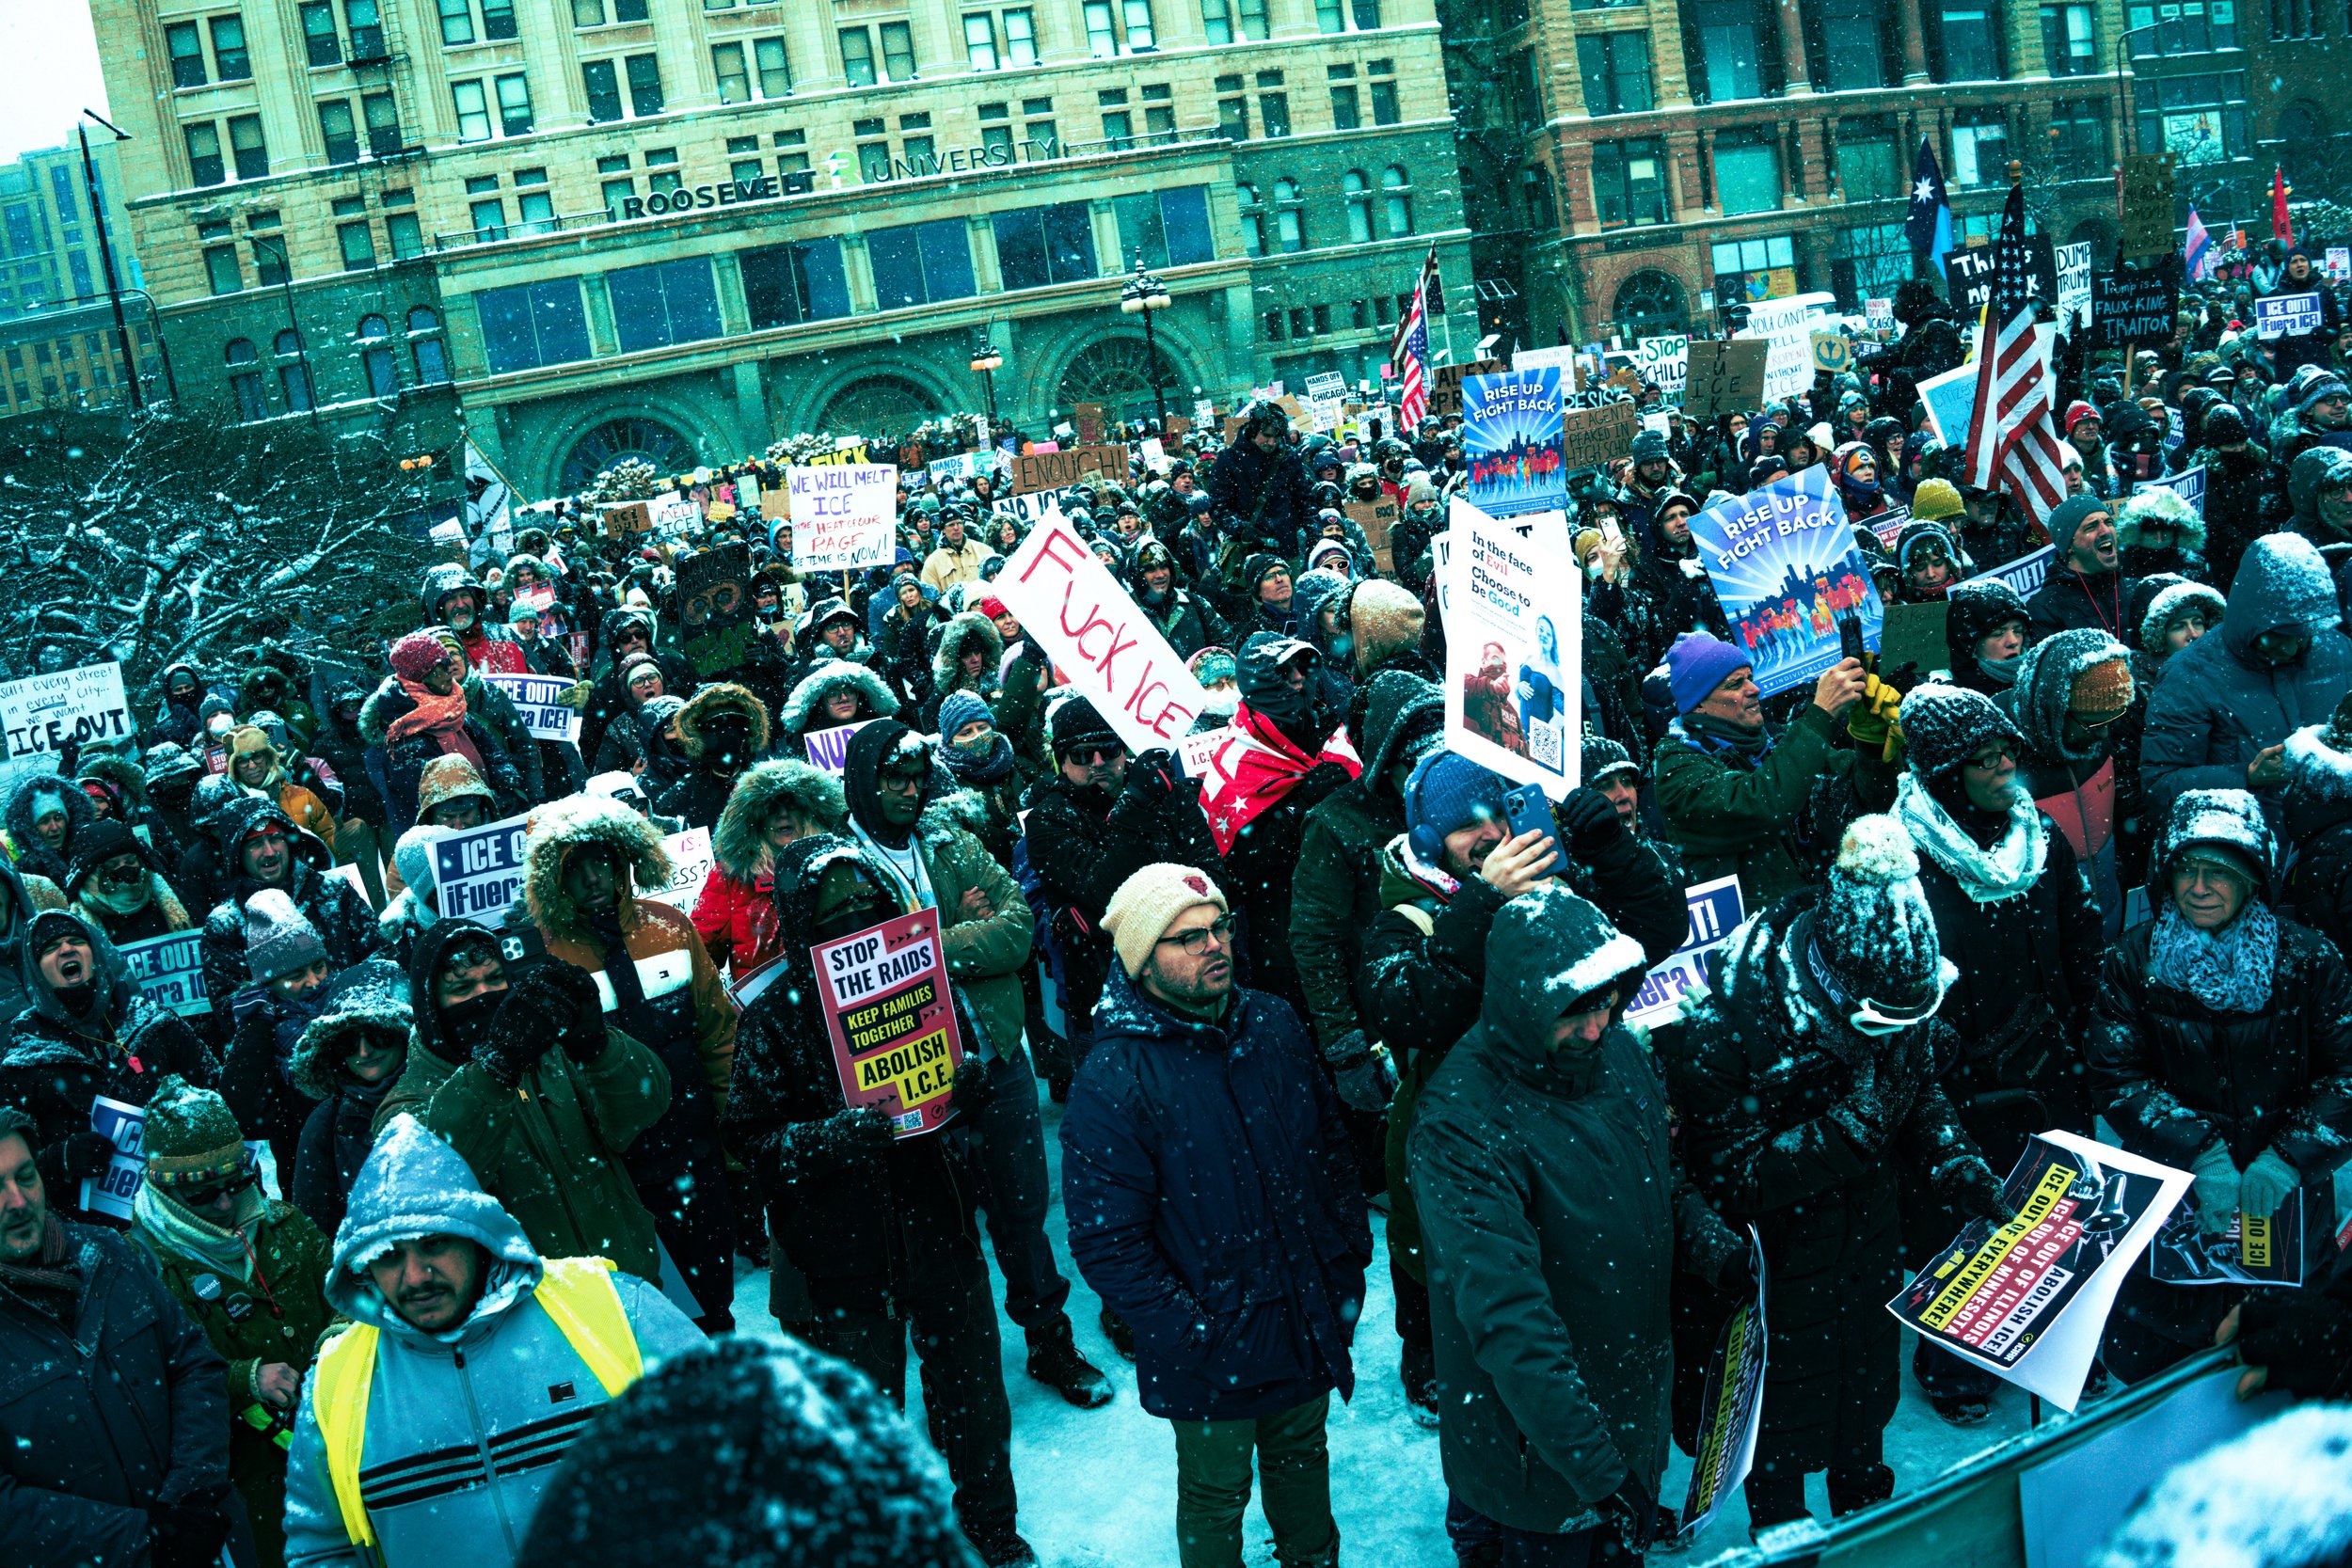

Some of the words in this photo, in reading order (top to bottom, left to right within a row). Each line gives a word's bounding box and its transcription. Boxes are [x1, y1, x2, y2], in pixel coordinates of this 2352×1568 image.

[623, 168, 817, 219] ROOSEVELT
[870, 137, 1054, 182] UNIVERSITY
[1951, 253, 1995, 277] Thi
[2056, 243, 2091, 272] DUMP
[2058, 269, 2091, 294] TRUMP
[2099, 278, 2137, 296] Trump
[2139, 280, 2150, 289] is
[2095, 294, 2169, 316] FAUX-KING
[2266, 299, 2284, 316] ICE
[2286, 297, 2311, 313] OUT!
[1748, 315, 1774, 336] YOU
[1777, 309, 1807, 329] CAN'T
[2102, 315, 2171, 340] TRAITOR
[2298, 313, 2319, 328] ICE!
[1645, 338, 1686, 361] STOP
[1768, 335, 1801, 350] PELL
[1307, 374, 1328, 386] HANDS
[1328, 372, 1341, 381] OFF
[1645, 361, 1688, 384] CHILD
[1765, 363, 1804, 380] WITHOUT
[1311, 388, 1346, 403] CHICAGO
[1484, 384, 1518, 403] RISE
[1522, 383, 1544, 396] UP
[1764, 373, 1802, 399] ICE
[1472, 401, 1515, 423] FIGHT
[1518, 399, 1557, 415] BACK
[1588, 403, 1634, 428] AGENTS
[1569, 429, 1613, 448] PEAKED
[1615, 422, 1629, 438] IN
[809, 445, 871, 467] FUCK
[931, 456, 964, 472] HANDS
[1565, 442, 1601, 467] HIGH
[1603, 437, 1633, 459] SCHOO
[1021, 447, 1124, 488] ENOUGH!
[790, 475, 811, 495] WE
[815, 471, 852, 491] WILL
[854, 469, 892, 485] MELT
[660, 504, 694, 522] MELT
[813, 493, 853, 515] ICE
[999, 498, 1029, 520] NO
[1375, 504, 1394, 518] BOOT
[663, 517, 695, 536] ICE
[817, 520, 844, 535] HEAT
[858, 515, 882, 526] OUR
[1723, 504, 1773, 540] RISE
[1775, 494, 1810, 514] UP
[1874, 521, 1898, 532] ABOLISH
[806, 553, 833, 566] TIME
[837, 553, 847, 562] IS
[850, 533, 888, 566] NOW!
[811, 532, 865, 553] RAGE
[1717, 526, 1773, 571] FIGHT
[1775, 510, 1836, 537] BACK
[1472, 531, 1485, 547] In
[1486, 540, 1507, 560] the
[1508, 552, 1534, 576] face
[1472, 548, 1485, 562] of
[1486, 554, 1508, 576] Evil
[1471, 565, 1517, 600] Choose
[1518, 593, 1531, 608] to
[1471, 579, 1486, 598] be
[1488, 591, 1520, 617] Good
[1018, 528, 1137, 693] FUCK
[1123, 660, 1195, 740] ICE
[33, 676, 71, 691] every
[1775, 662, 1822, 685] INDIVISIBLE
[8, 705, 18, 715] in
[26, 693, 68, 710] every
[25, 715, 42, 725] we
[53, 704, 86, 719] want
[538, 707, 568, 730] ICE!
[7, 721, 62, 756] ICE
[75, 708, 125, 744] OUT
[1191, 750, 1215, 767] I.C.E
[461, 834, 503, 875] ICE
[126, 949, 156, 979] CE
[830, 937, 880, 972] STOP
[834, 968, 875, 1000] THE
[877, 944, 932, 986] RAIDS
[1807, 943, 1842, 1006] bollé
[847, 1006, 880, 1031] KEEP
[882, 985, 933, 1019] FAMILIES
[851, 1014, 915, 1050] TOGETHER
[863, 1034, 946, 1086] ABOLISH
[903, 1063, 952, 1101] I.C.E.
[2043, 1167, 2070, 1193] ICE
[2023, 1195, 2051, 1222] OUT
[2048, 1198, 2074, 1222] ICE
[2005, 1223, 2026, 1238] OF
[2025, 1224, 2054, 1245] OUT
[2059, 1220, 2082, 1243] ICE
[2249, 1214, 2265, 1238] OU
[2009, 1245, 2029, 1264] OF
[2035, 1242, 2060, 1268] OUT
[2249, 1243, 2265, 1264] ICE
[198, 1278, 221, 1298] resist.
[1924, 1237, 2009, 1328] EVERYWHERE!
[2014, 1269, 2036, 1289] OF
[1944, 1265, 2013, 1335] MINNESOTA
[2010, 1267, 2065, 1324] ABOLISH
[1963, 1289, 2020, 1344] ILLINOIS
[1729, 1331, 1742, 1361] OUT
[1983, 1325, 2015, 1354] ICE!
[2004, 1343, 2026, 1361] ICIRR
[1724, 1366, 1736, 1388] OF
